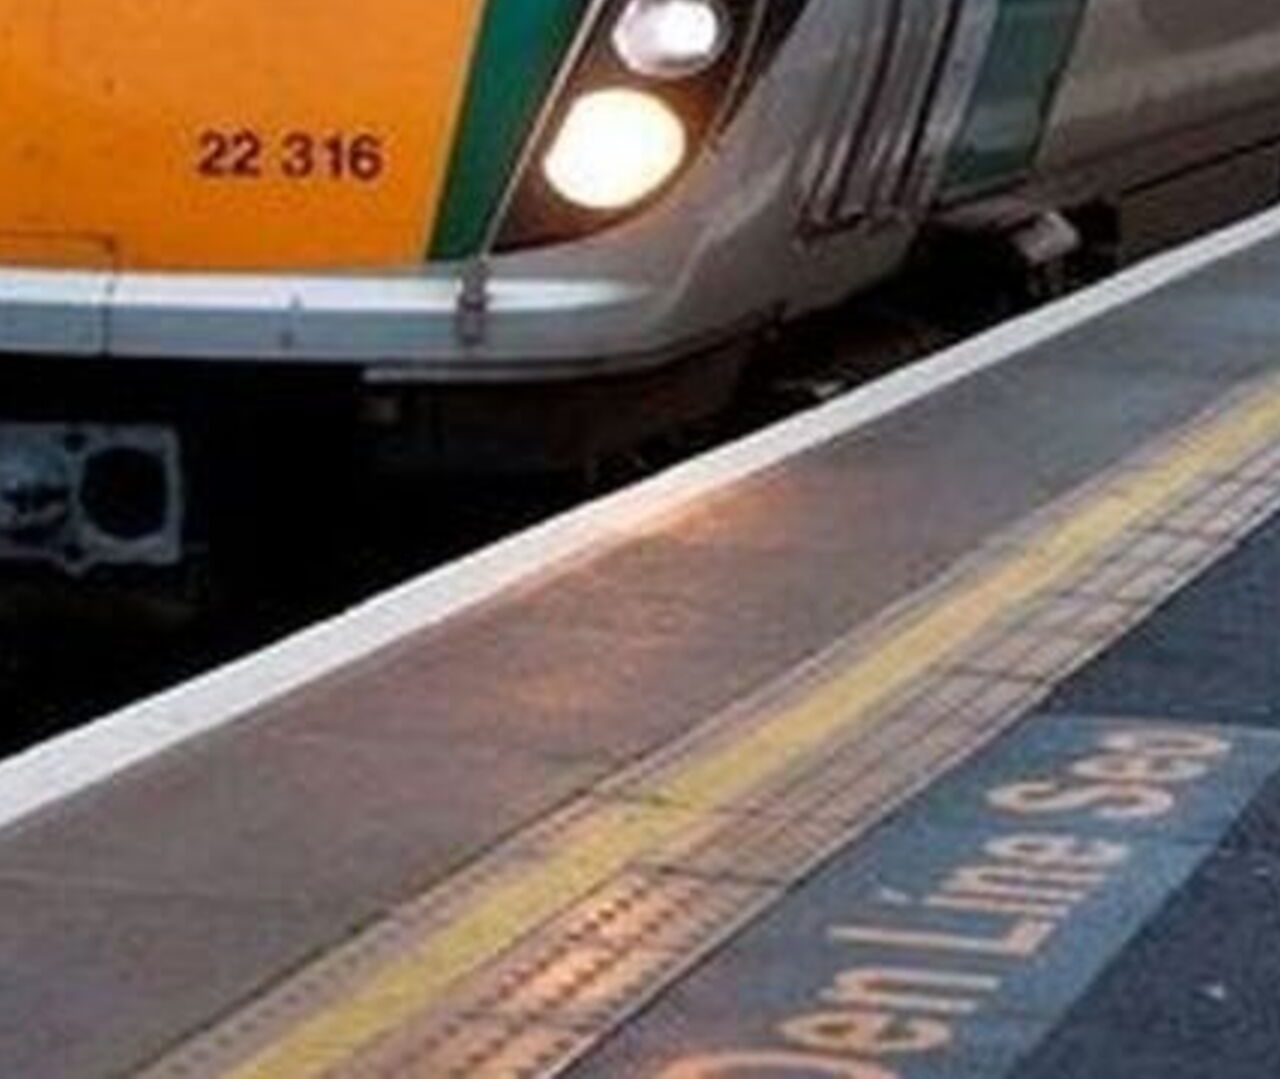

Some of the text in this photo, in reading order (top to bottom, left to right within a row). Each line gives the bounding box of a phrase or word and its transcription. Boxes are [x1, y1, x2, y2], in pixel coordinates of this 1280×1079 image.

[197, 128, 384, 182] 22 316
[982, 726, 1231, 818] Seo
